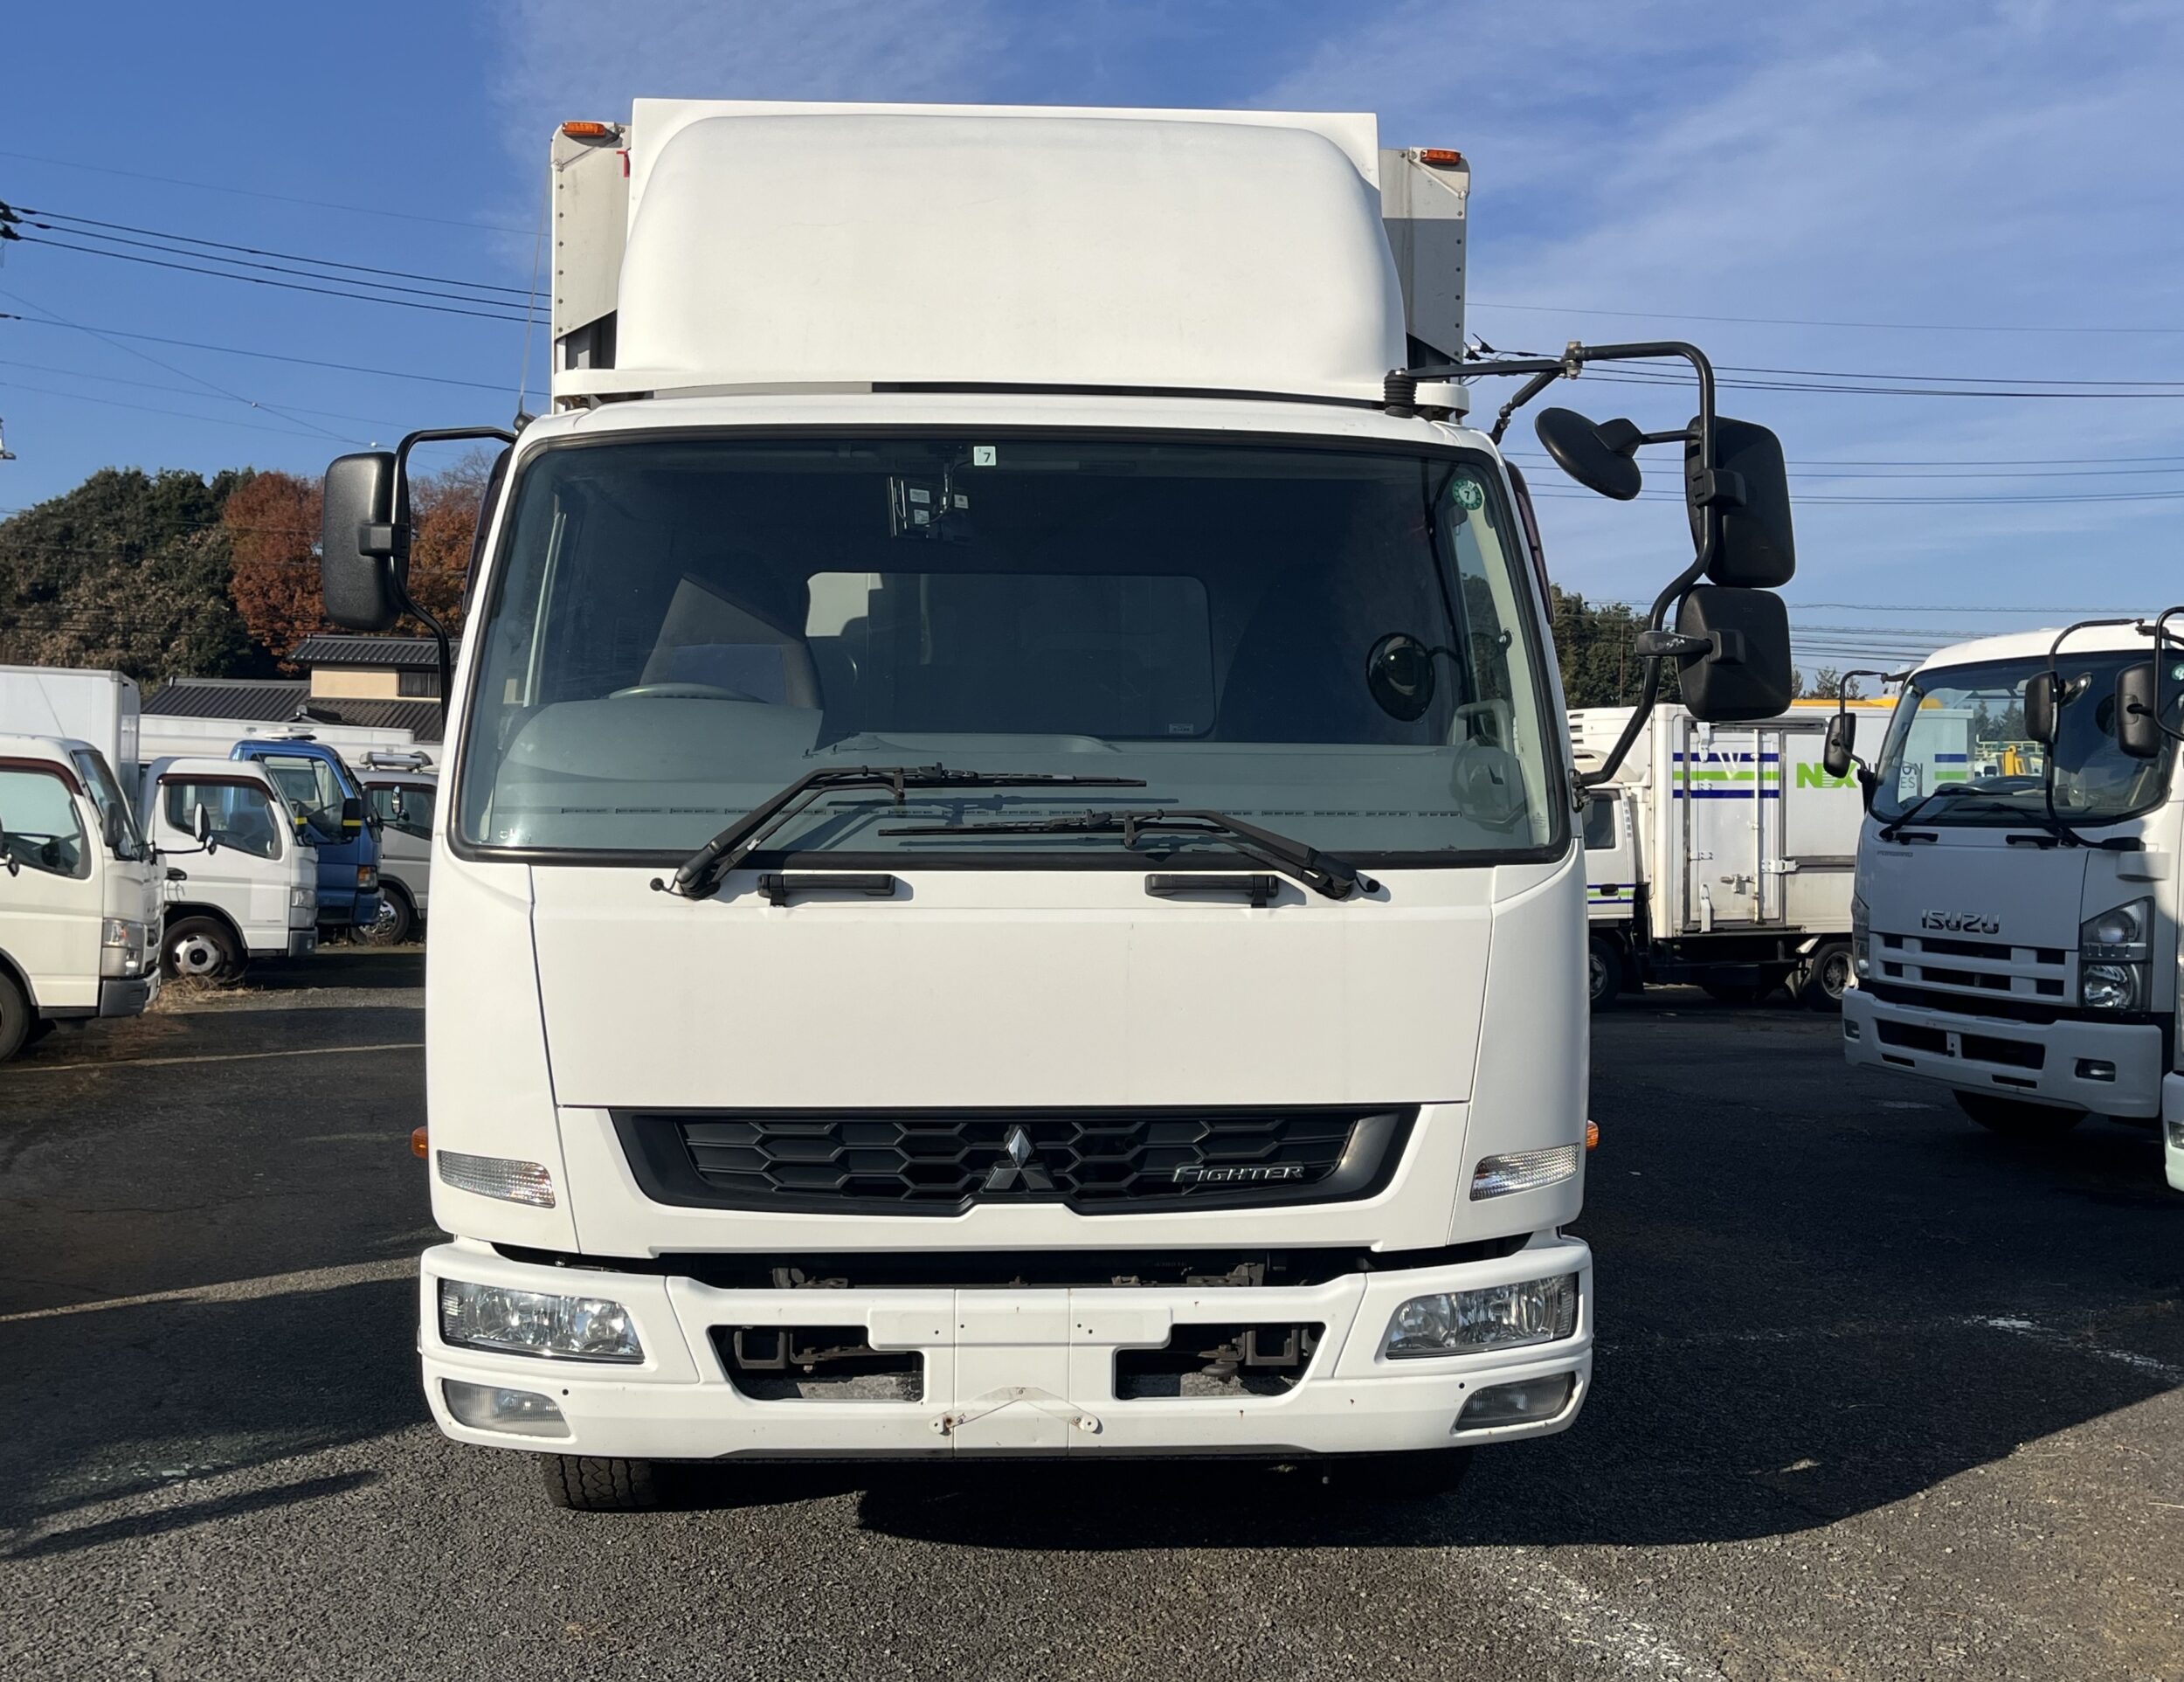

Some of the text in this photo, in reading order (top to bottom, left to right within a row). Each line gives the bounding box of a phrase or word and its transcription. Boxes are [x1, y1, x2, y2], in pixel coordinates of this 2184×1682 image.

[984, 452, 991, 463] 7
[1464, 490, 1470, 500] 7
[1922, 909, 2000, 934] ISUZU
[1172, 1165, 1304, 1182] FIGHTER
